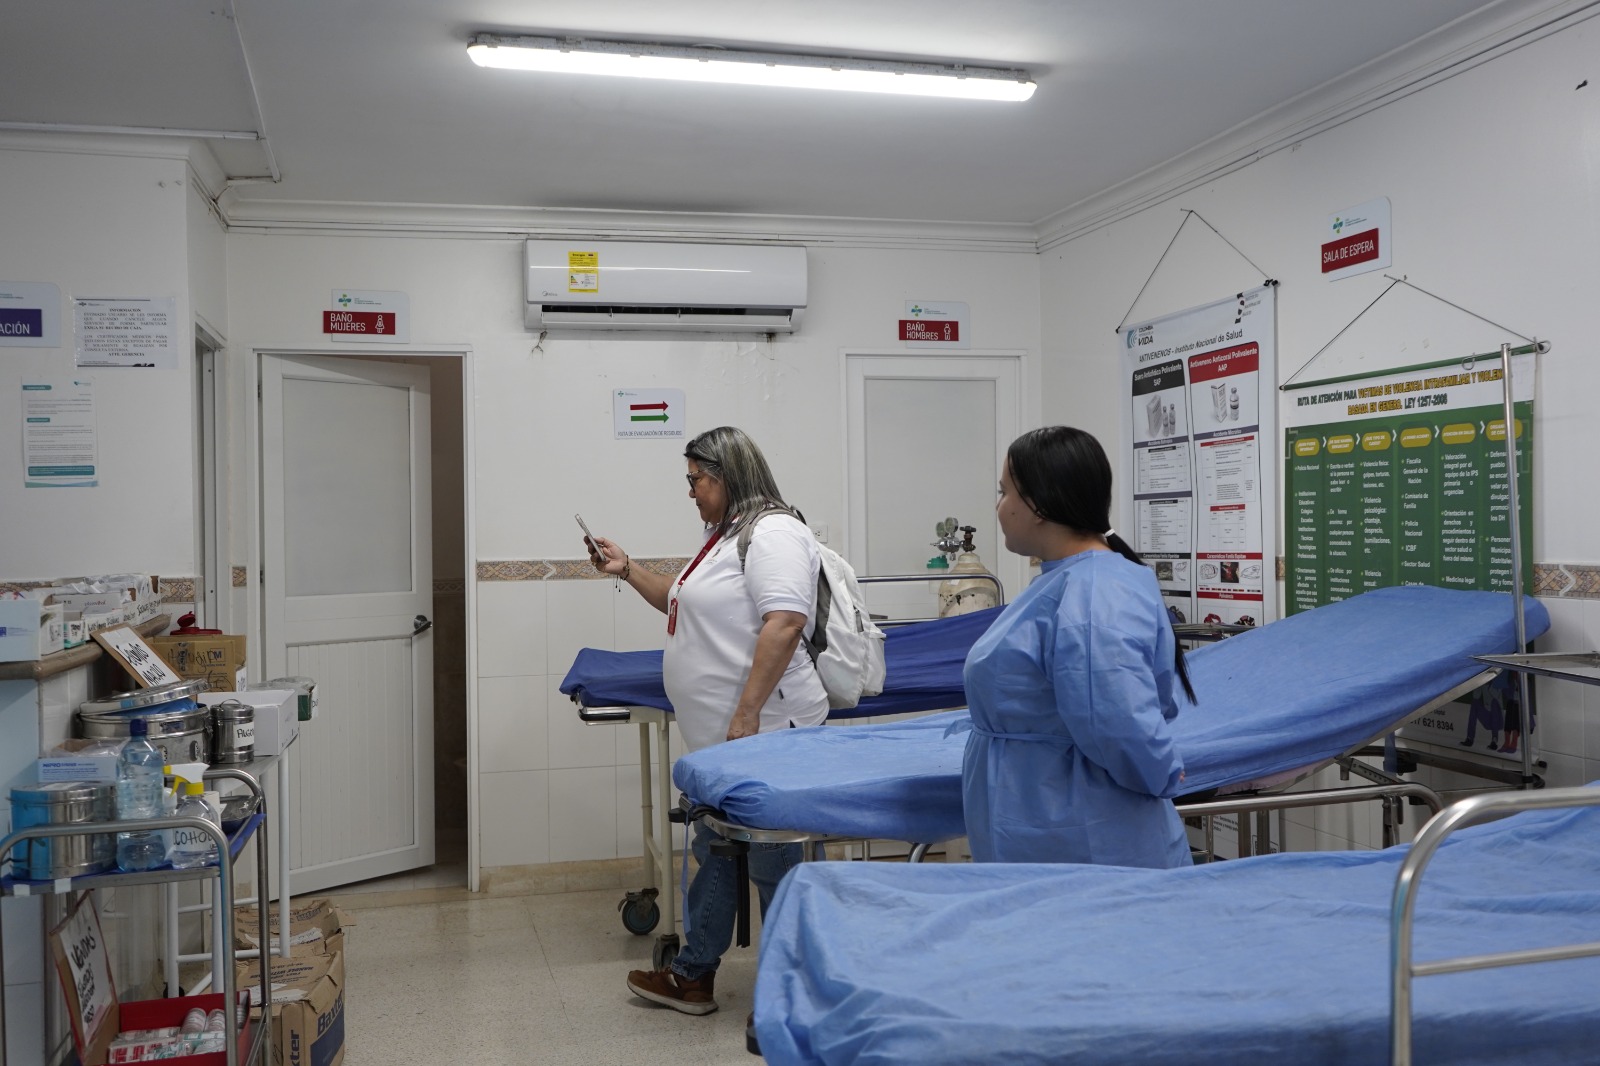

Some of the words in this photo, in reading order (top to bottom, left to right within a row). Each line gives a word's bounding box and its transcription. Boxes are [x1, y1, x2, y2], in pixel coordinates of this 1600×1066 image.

[1324, 250, 1339, 264] SALA
[1340, 246, 1348, 259] DE
[1350, 240, 1374, 256] ESPERA
[330, 312, 352, 322] BAÑO
[330, 322, 366, 332] MUJERES
[906, 322, 925, 332] BAÑO
[906, 331, 939, 340] HOMBRES
[1138, 335, 1153, 346] VIDA
[1195, 335, 1217, 349] Nacional
[1218, 333, 1224, 342] de
[1226, 329, 1243, 340] Salud
[1232, 348, 1257, 358] Polivalente
[1297, 396, 1309, 406] RUTA
[1311, 395, 1317, 405] DE
[1318, 390, 1343, 404] ATENCIÓN
[1343, 390, 1357, 400] PARA
[1384, 384, 1392, 395] DE
[1392, 380, 1422, 394] VIOLENCIA
[1471, 371, 1477, 383] Y
[1477, 368, 1503, 382] VIOLEN
[1348, 404, 1368, 416] BASADA
[1370, 402, 1377, 413] EN
[1405, 397, 1416, 409] LEY
[1417, 393, 1448, 408] 1257-2008
[1422, 718, 1434, 728] 621
[1437, 720, 1454, 731] 8394
